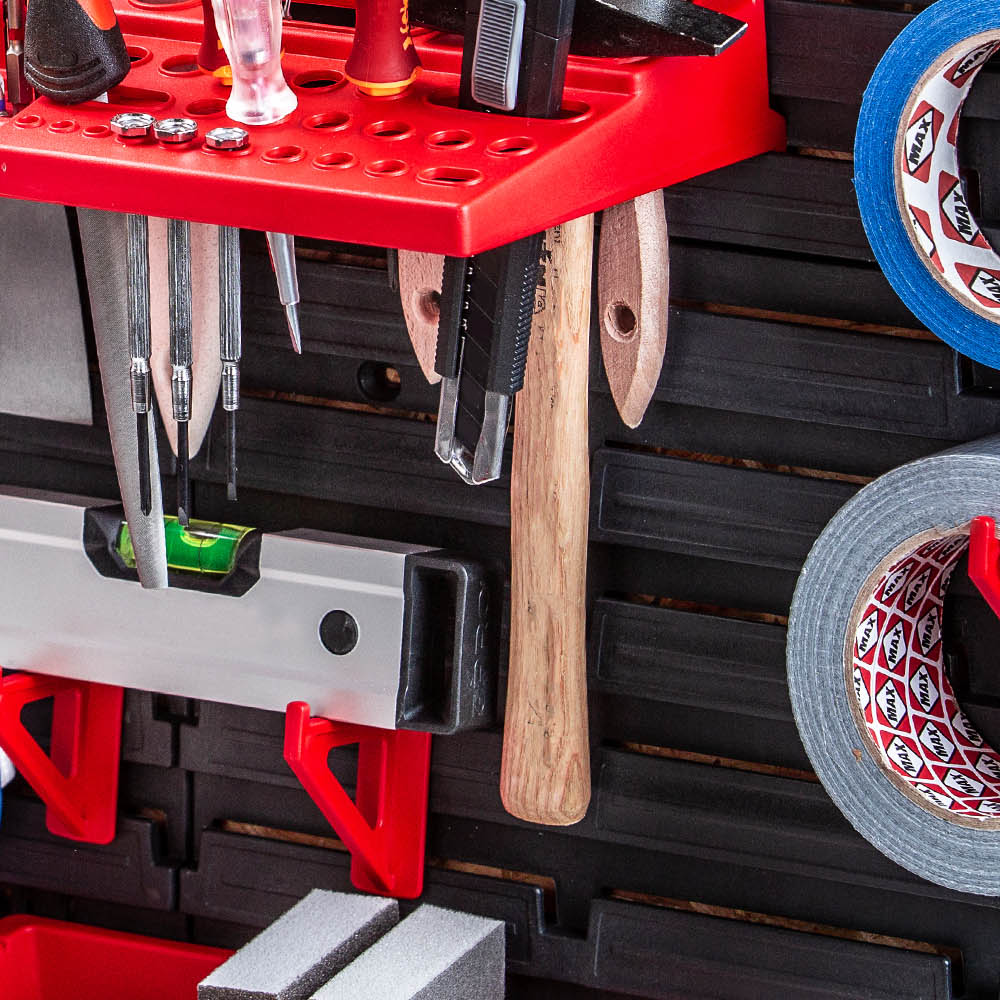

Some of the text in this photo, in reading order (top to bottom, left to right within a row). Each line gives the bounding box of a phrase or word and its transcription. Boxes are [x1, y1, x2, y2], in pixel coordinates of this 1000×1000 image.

[908, 118, 932, 165] MAX
[953, 190, 973, 236] MAX
[884, 567, 909, 597] MAX
[906, 573, 929, 606] MAX
[858, 617, 877, 652] MAX
[888, 627, 903, 664] MAX
[922, 613, 937, 649] MAX
[885, 686, 898, 722] MAX
[918, 671, 931, 707] MAX
[893, 742, 917, 773] MAX
[926, 727, 949, 758] MAX
[949, 772, 980, 795] MAX
